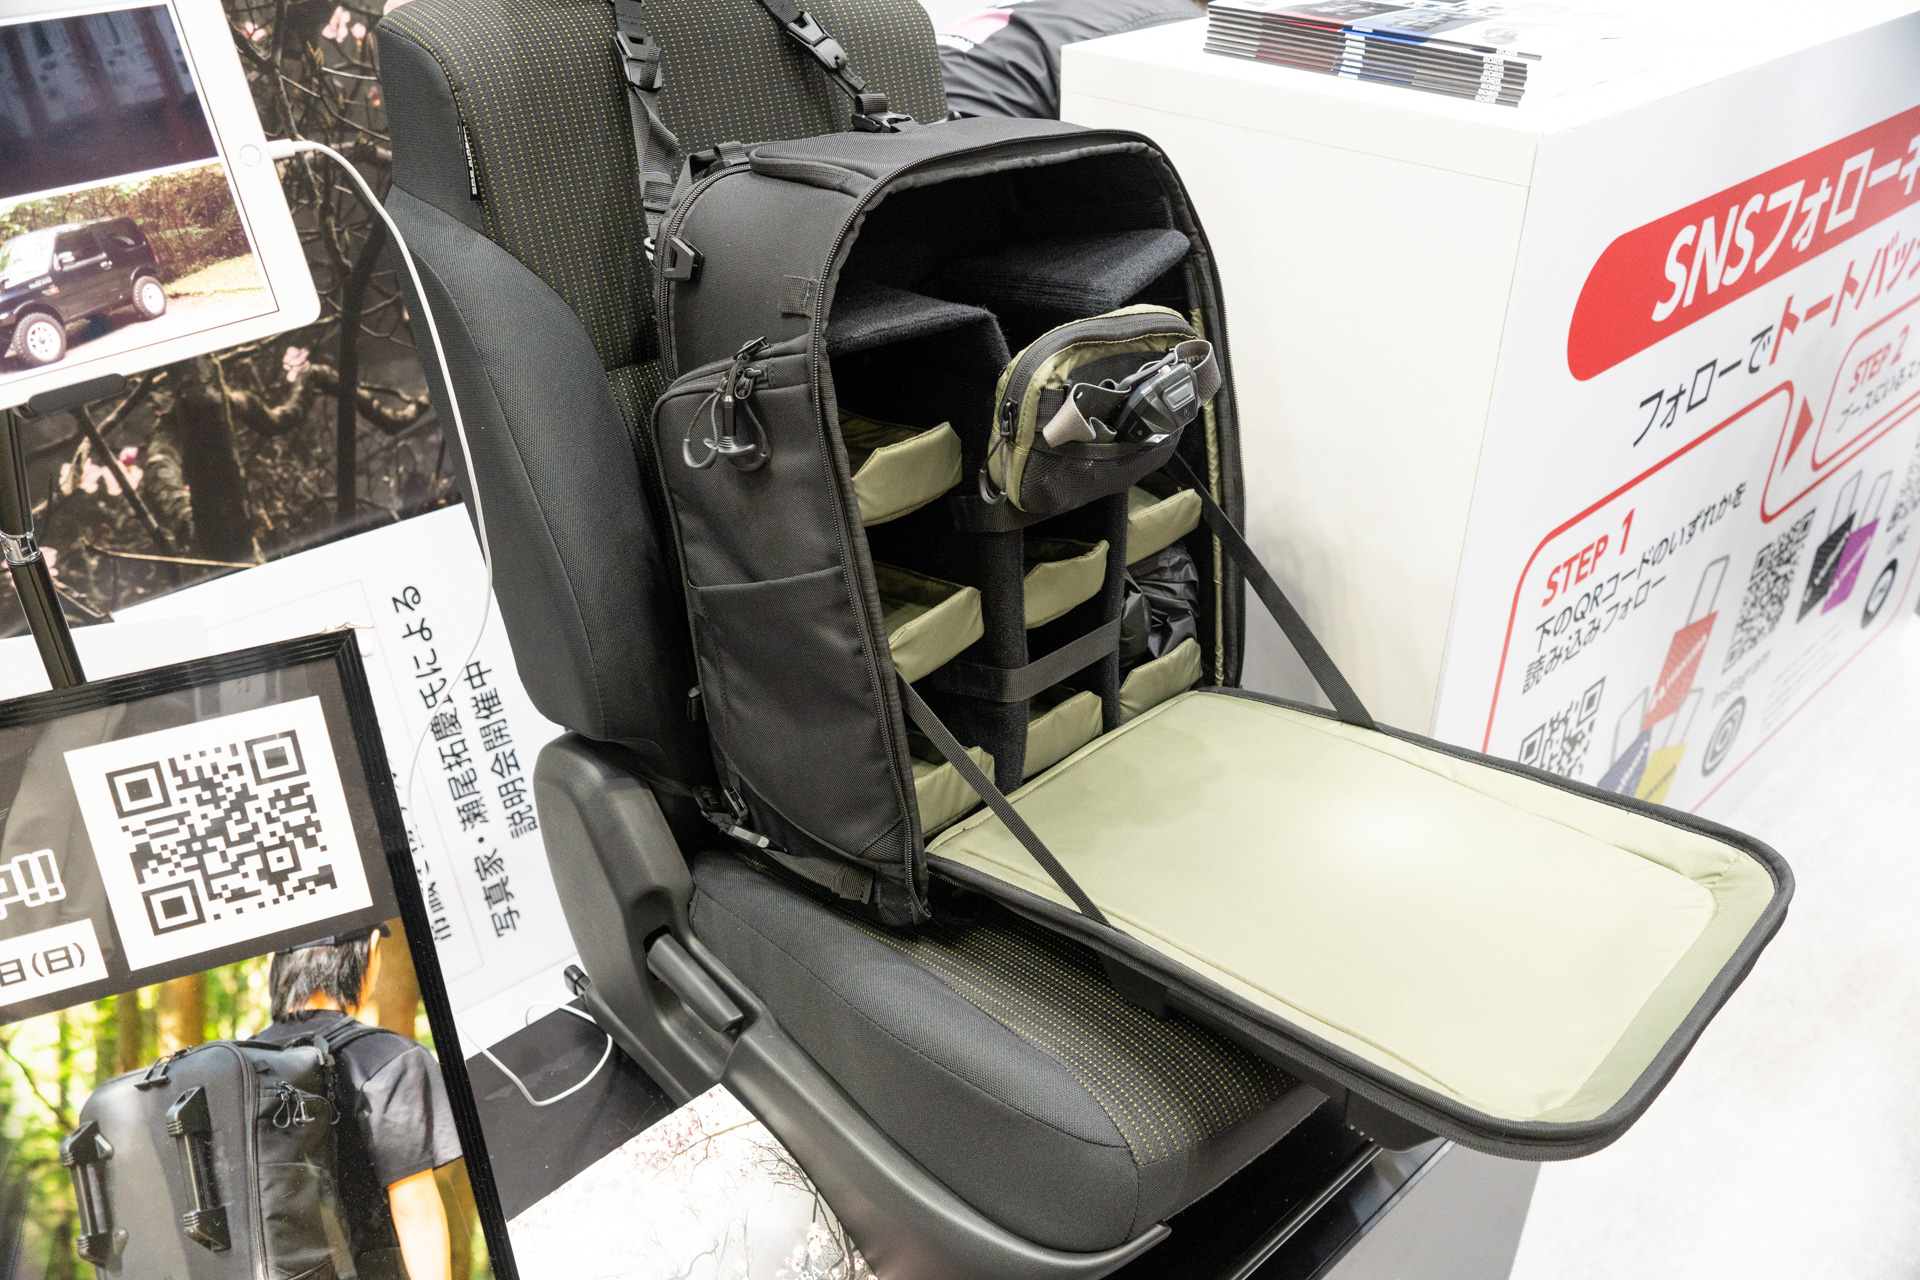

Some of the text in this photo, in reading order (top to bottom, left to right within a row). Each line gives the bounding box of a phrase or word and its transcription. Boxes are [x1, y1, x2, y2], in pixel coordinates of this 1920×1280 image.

[1633, 230, 1920, 448] フォローでトートバッ
[1849, 323, 1911, 395] STEP 2
[1522, 575, 1667, 695] 読み込みフォロー
[1535, 481, 1747, 653] 下のQRコードのいずれかを
[1541, 507, 1636, 608] STEP 1
[391, 585, 521, 938] 写真家・瀬尾拓慶氏による
[463, 659, 539, 840] 説明会開催中
